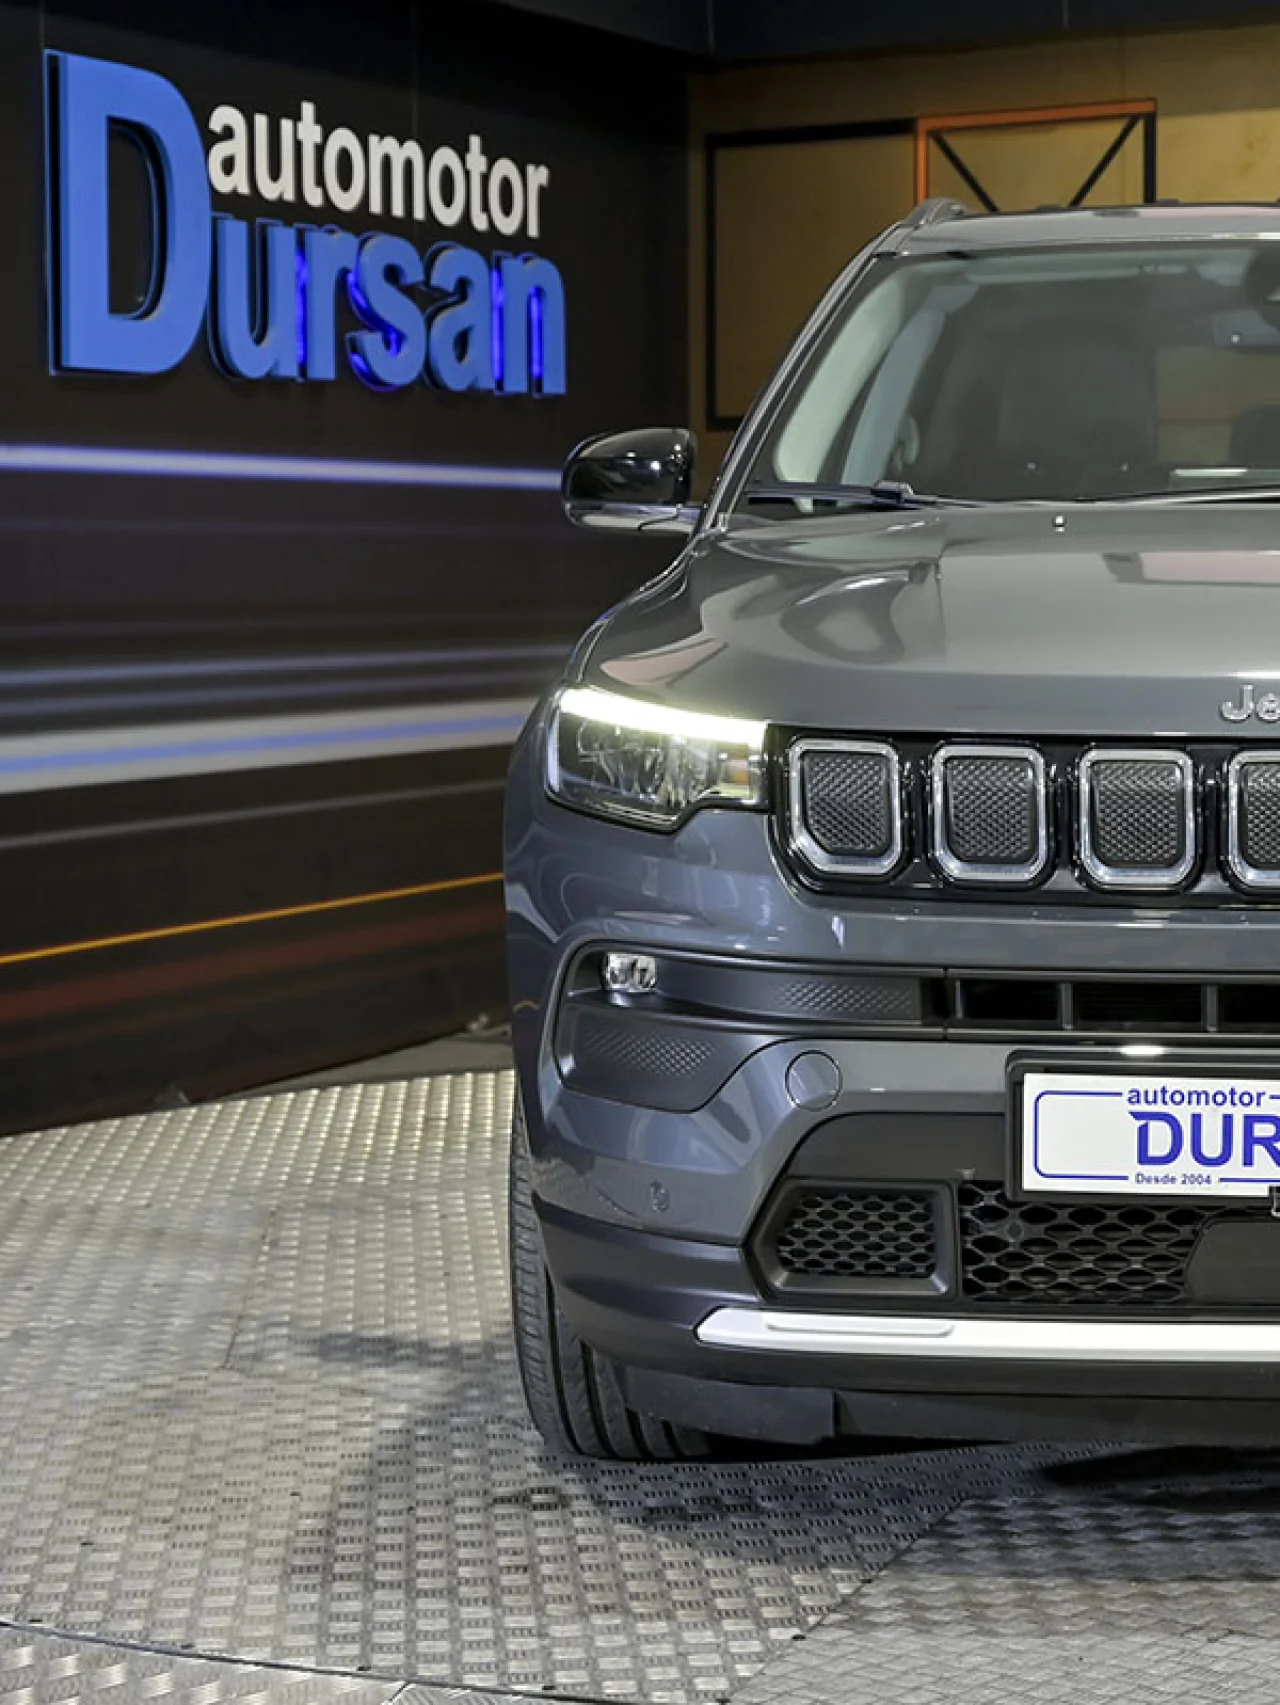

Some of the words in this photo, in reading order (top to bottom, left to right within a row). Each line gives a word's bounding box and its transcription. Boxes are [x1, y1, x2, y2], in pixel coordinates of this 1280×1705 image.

[208, 101, 549, 238] automotor
[44, 48, 567, 397] Dursan
[1126, 1085, 1267, 1108] automotor
[1135, 1172, 1177, 1185] Desde
[1181, 1173, 1212, 1186] 2004
